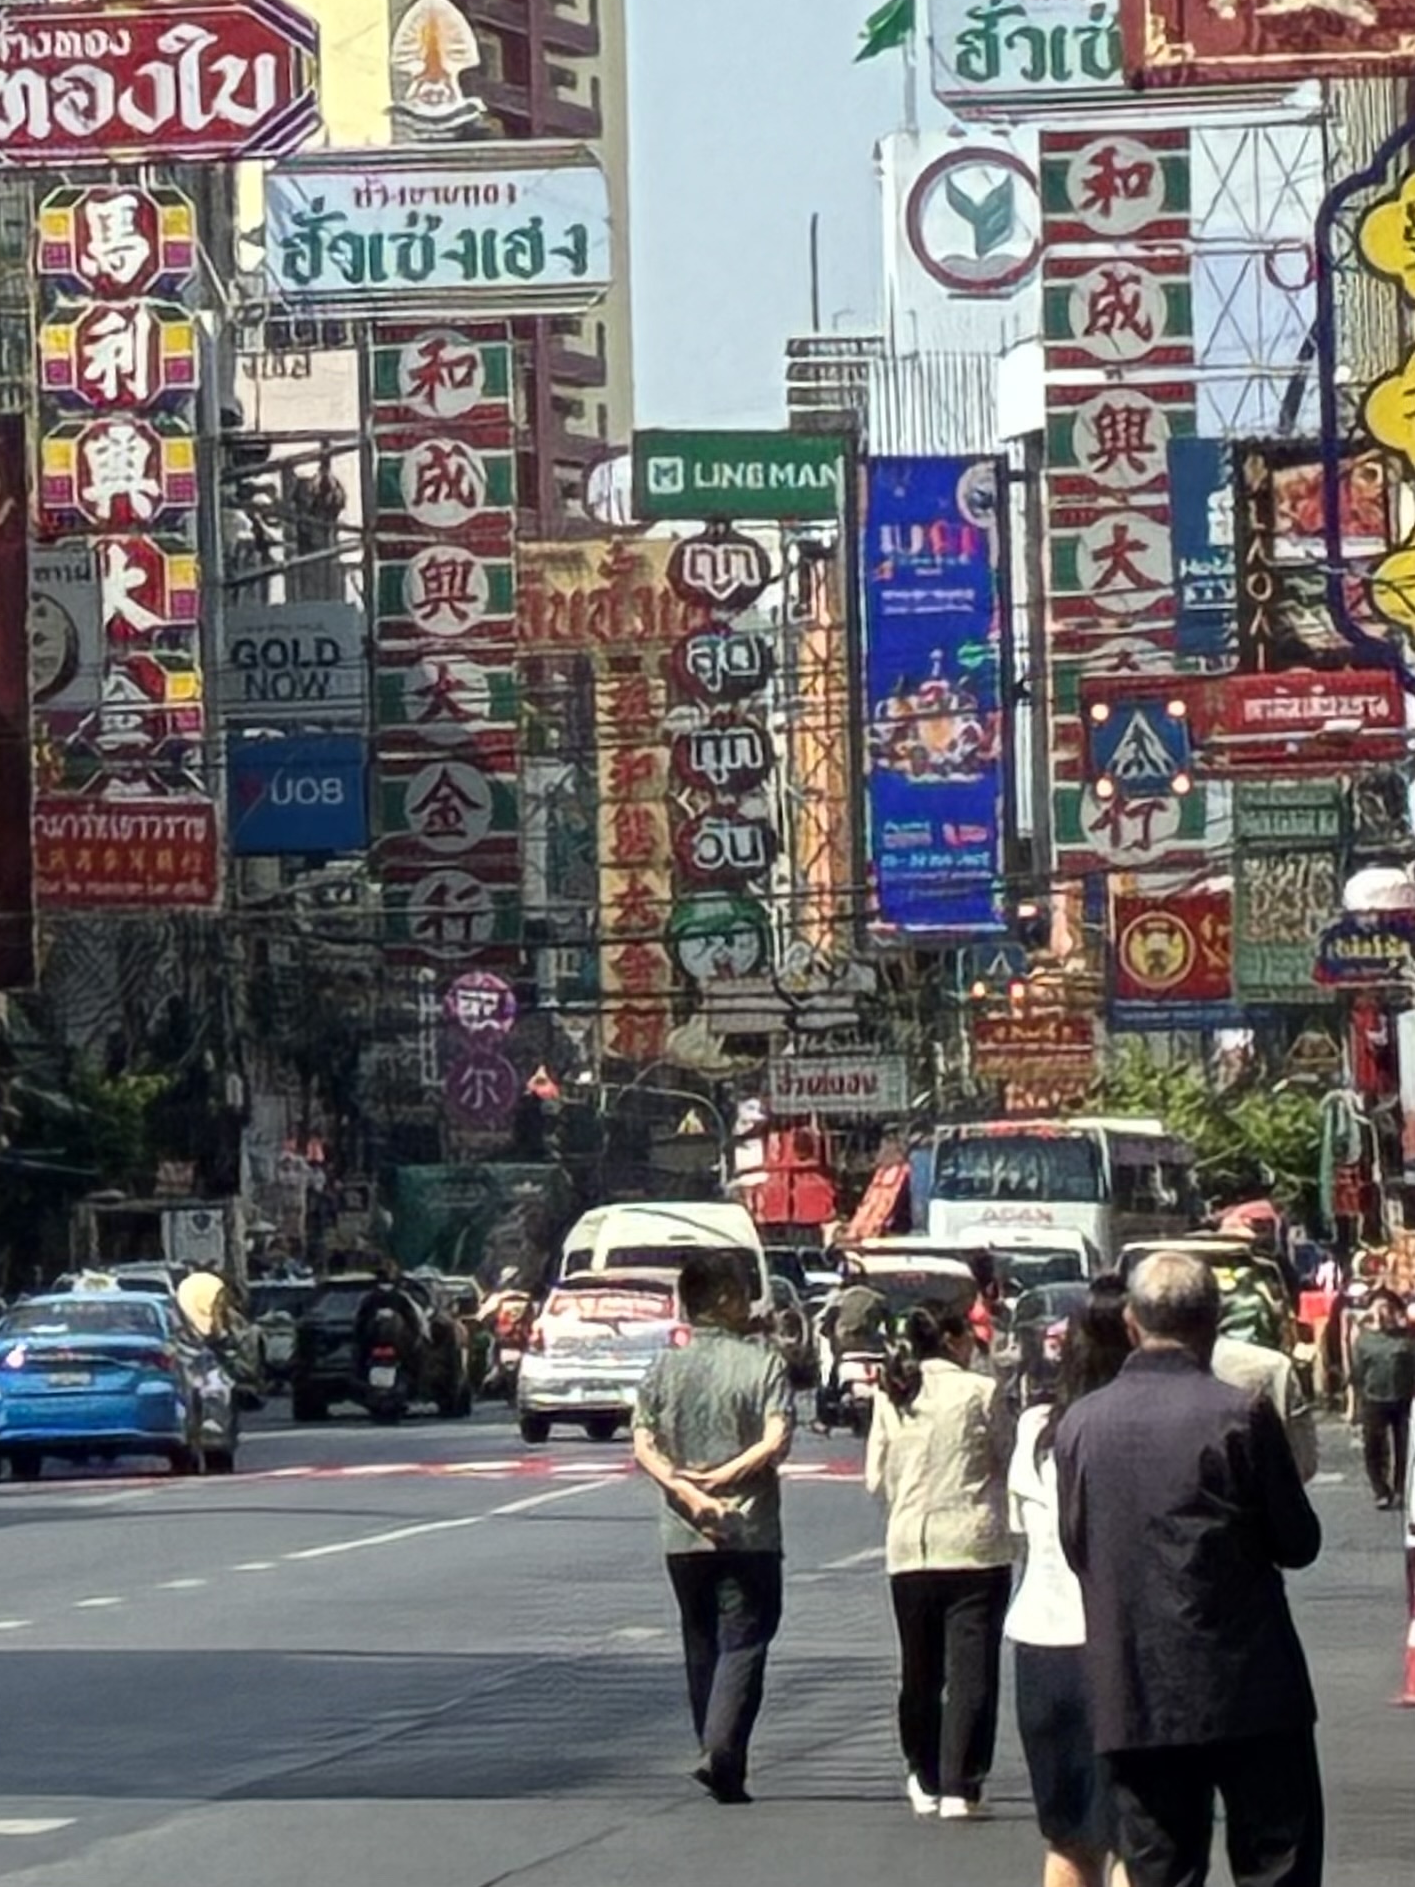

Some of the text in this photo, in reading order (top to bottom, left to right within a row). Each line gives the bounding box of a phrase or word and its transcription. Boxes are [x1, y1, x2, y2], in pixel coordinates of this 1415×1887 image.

[1079, 146, 1169, 851] 和成興大行
[231, 637, 342, 671] GOLD
[245, 672, 331, 702] NOW
[270, 777, 345, 806] UOB
